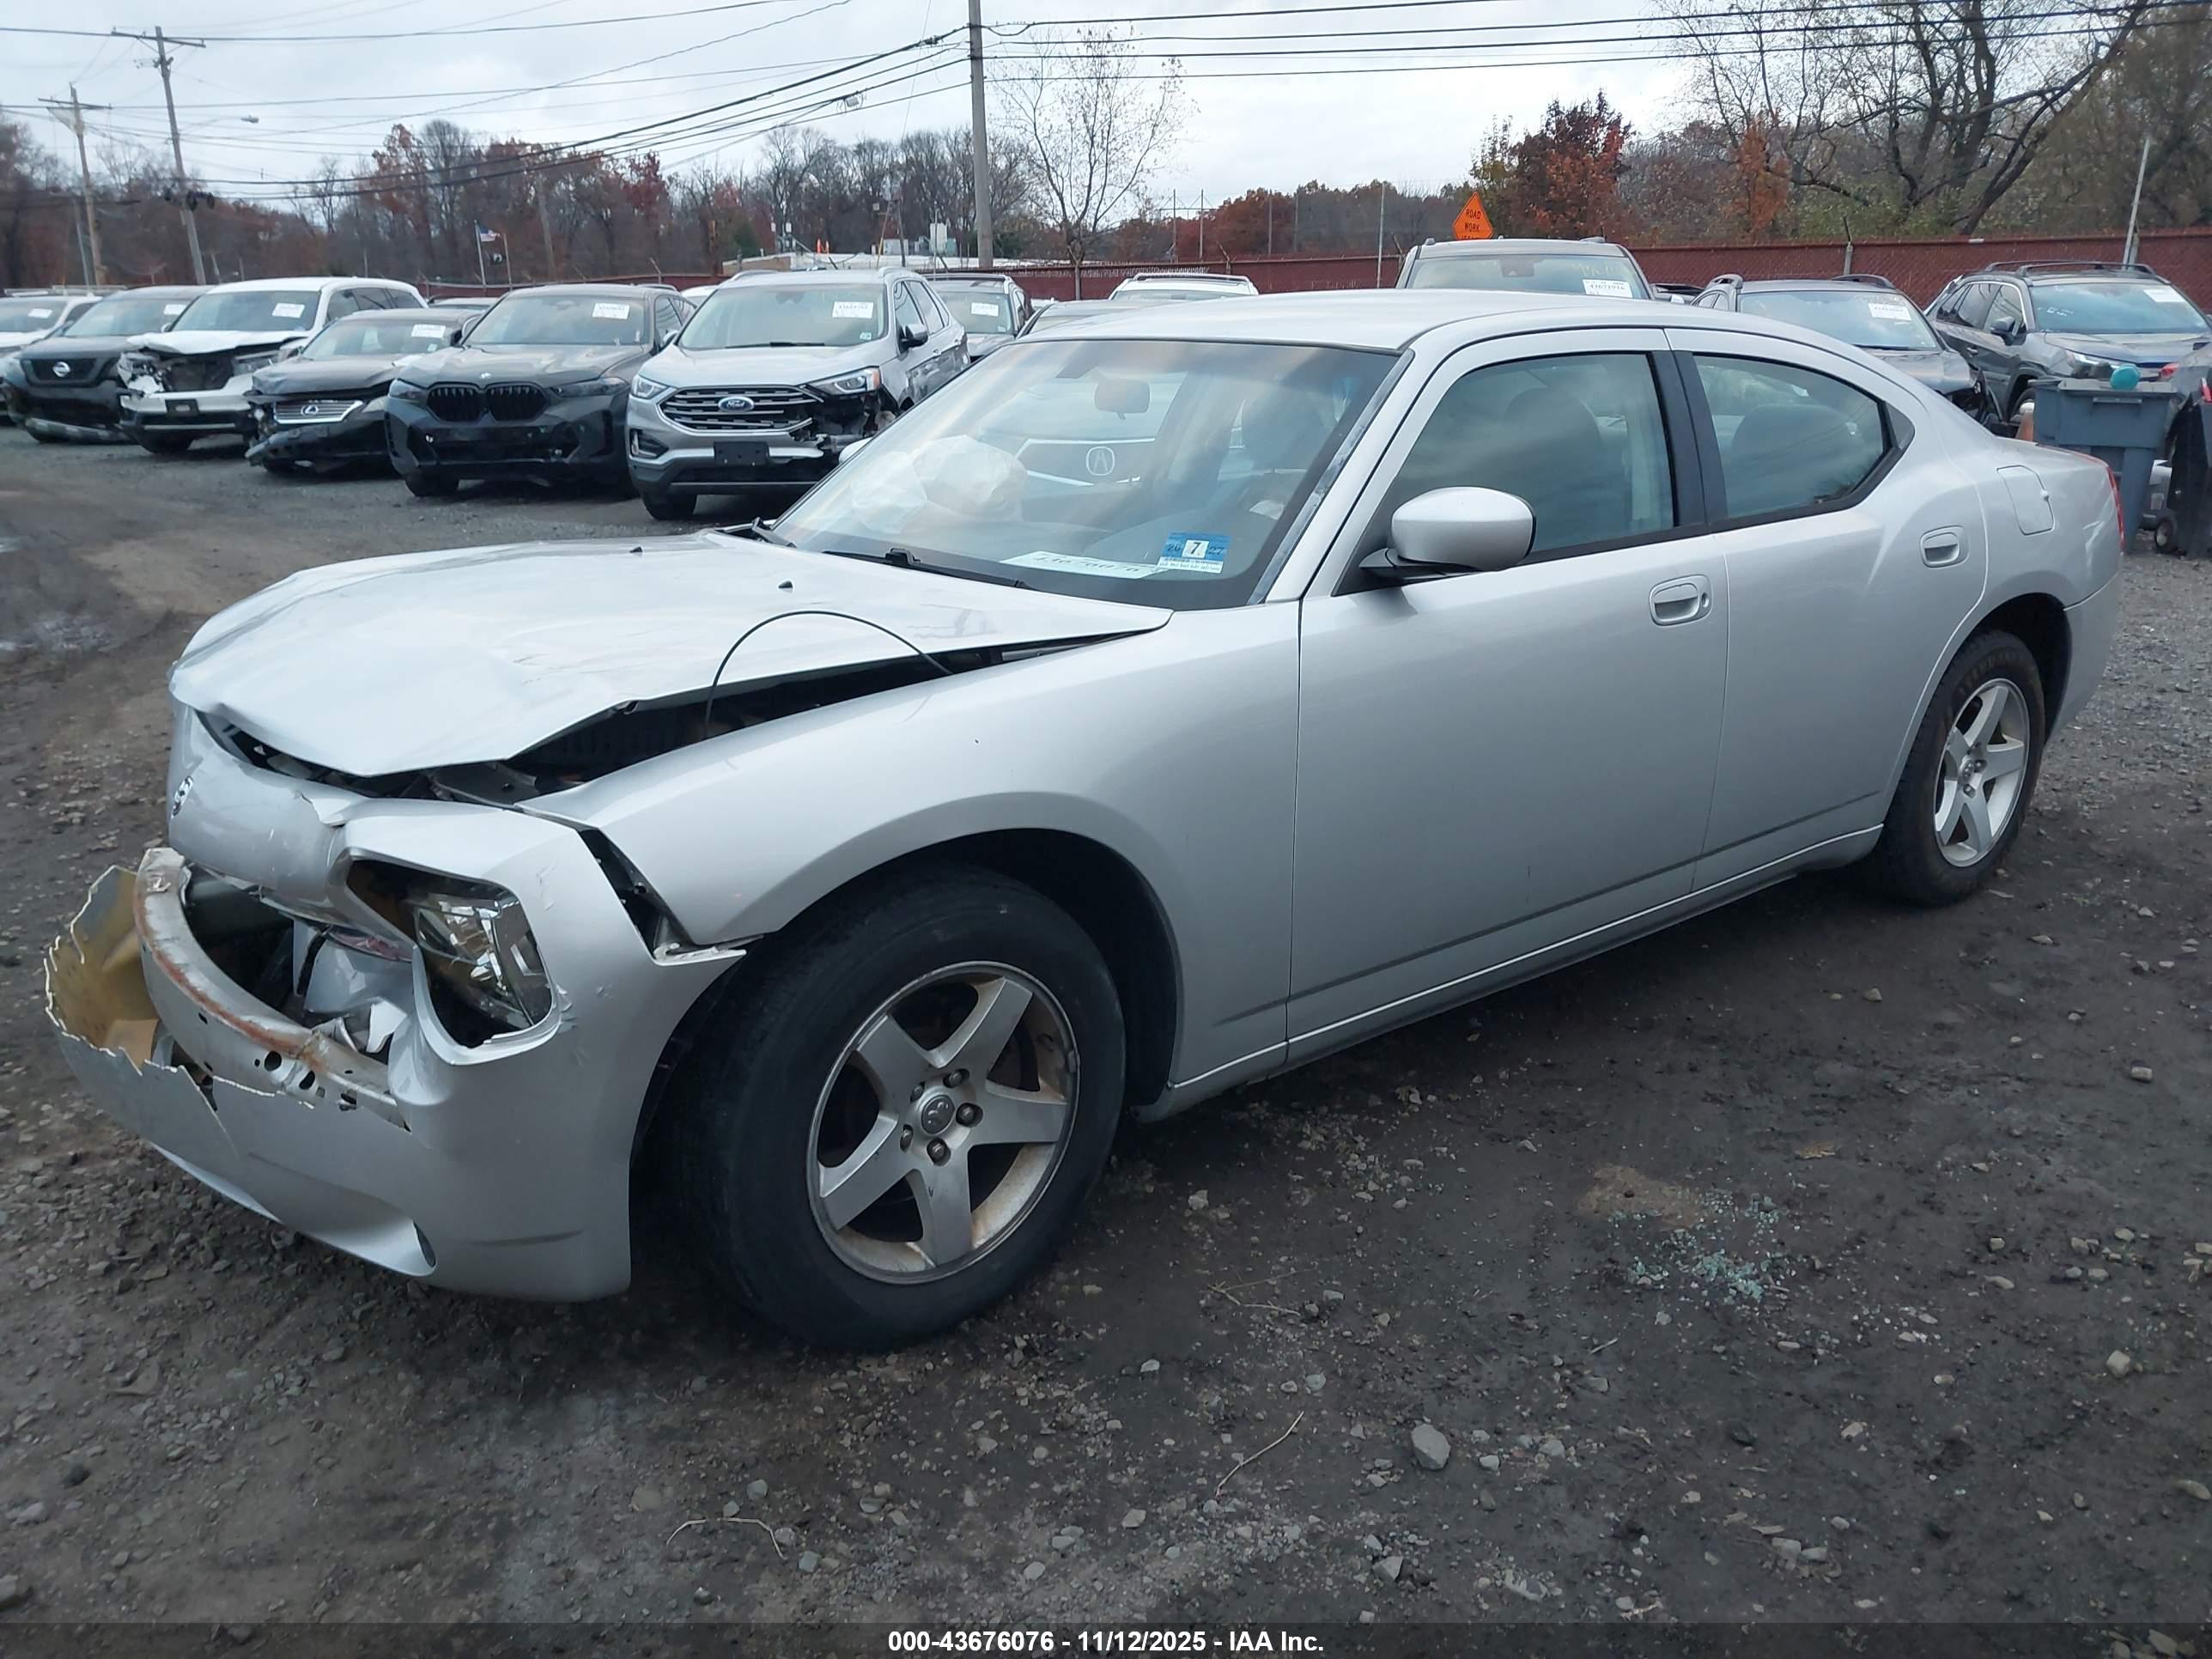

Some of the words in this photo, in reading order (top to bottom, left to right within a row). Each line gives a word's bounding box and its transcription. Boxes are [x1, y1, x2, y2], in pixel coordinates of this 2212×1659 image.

[1465, 209, 1481, 220] ROAD
[1464, 222, 1480, 233] WORK
[1190, 542, 1201, 554] 7
[1207, 546, 1224, 555] 27
